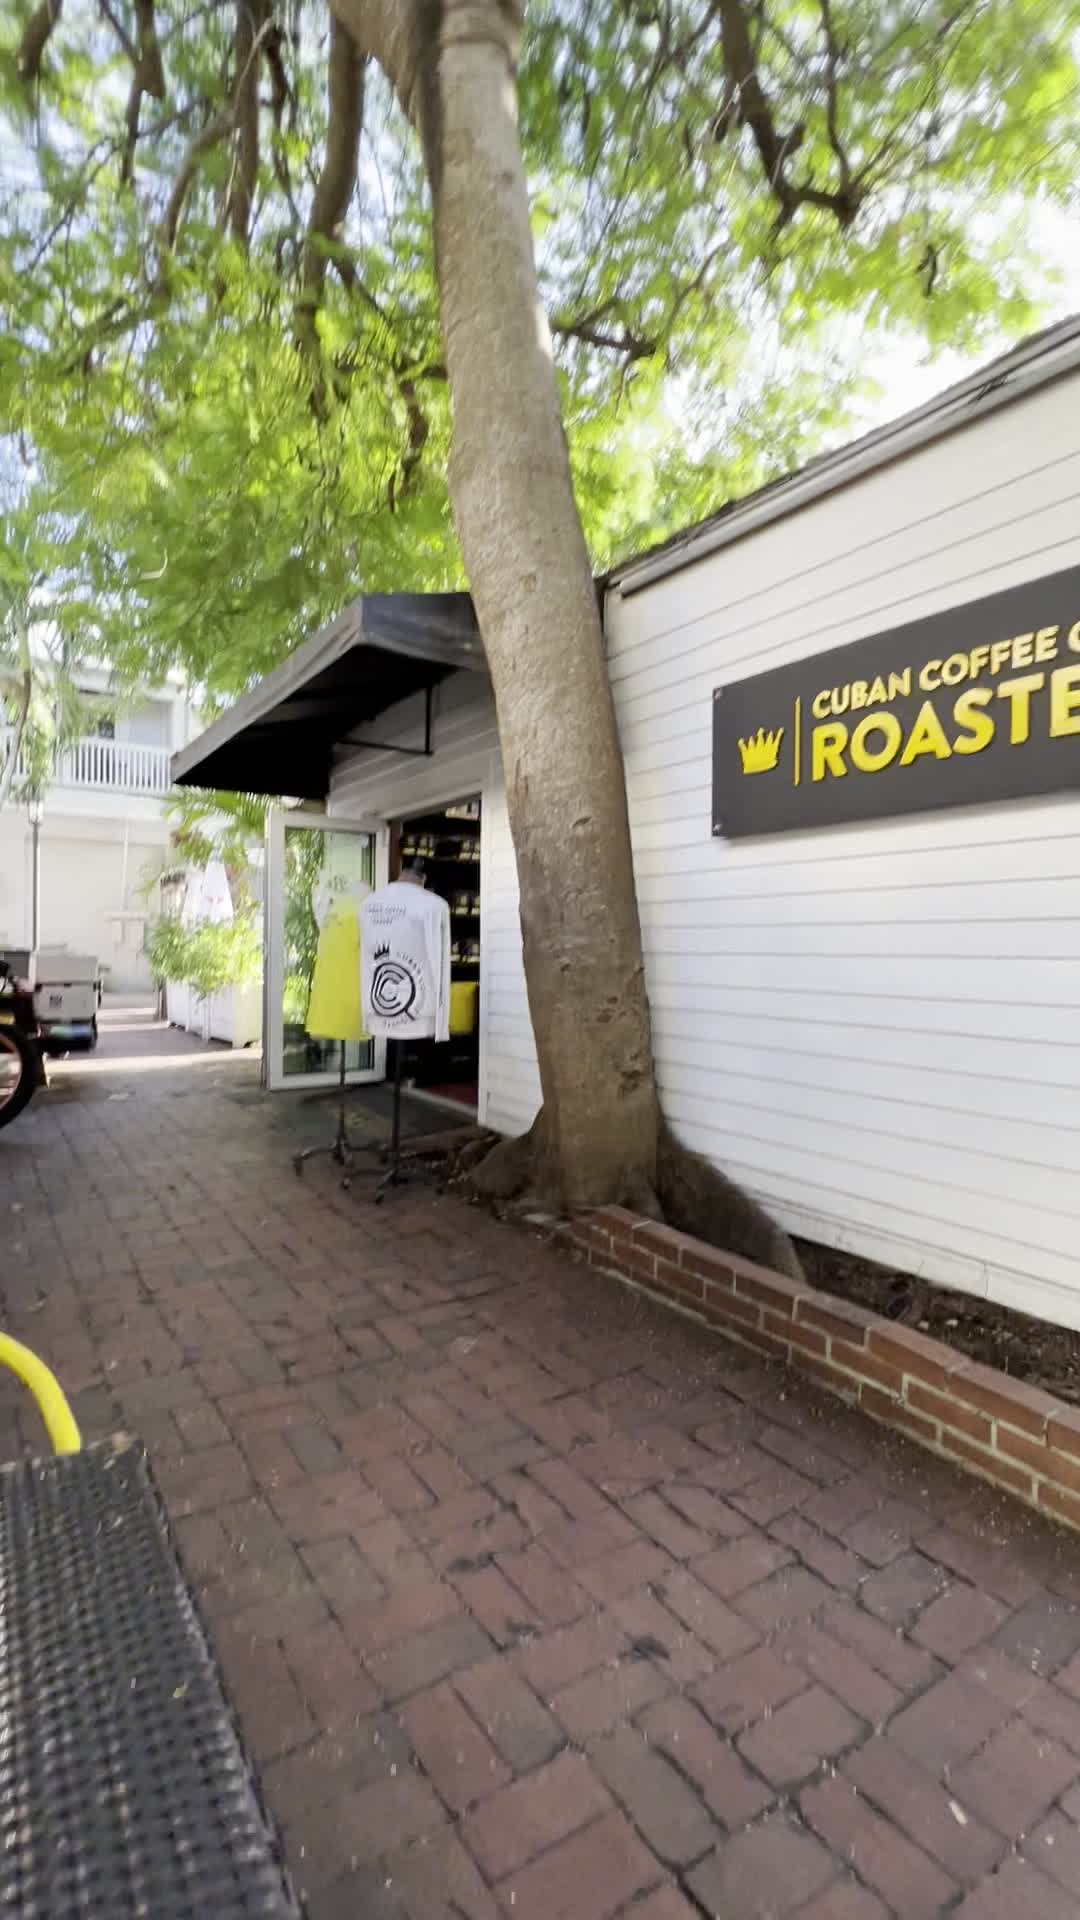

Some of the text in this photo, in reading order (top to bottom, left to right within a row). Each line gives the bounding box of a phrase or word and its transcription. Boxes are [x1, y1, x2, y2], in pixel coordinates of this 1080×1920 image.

[811, 667, 912, 720] CUBAN
[918, 624, 1060, 692] COFFEE
[811, 663, 1080, 783] ROASTE
